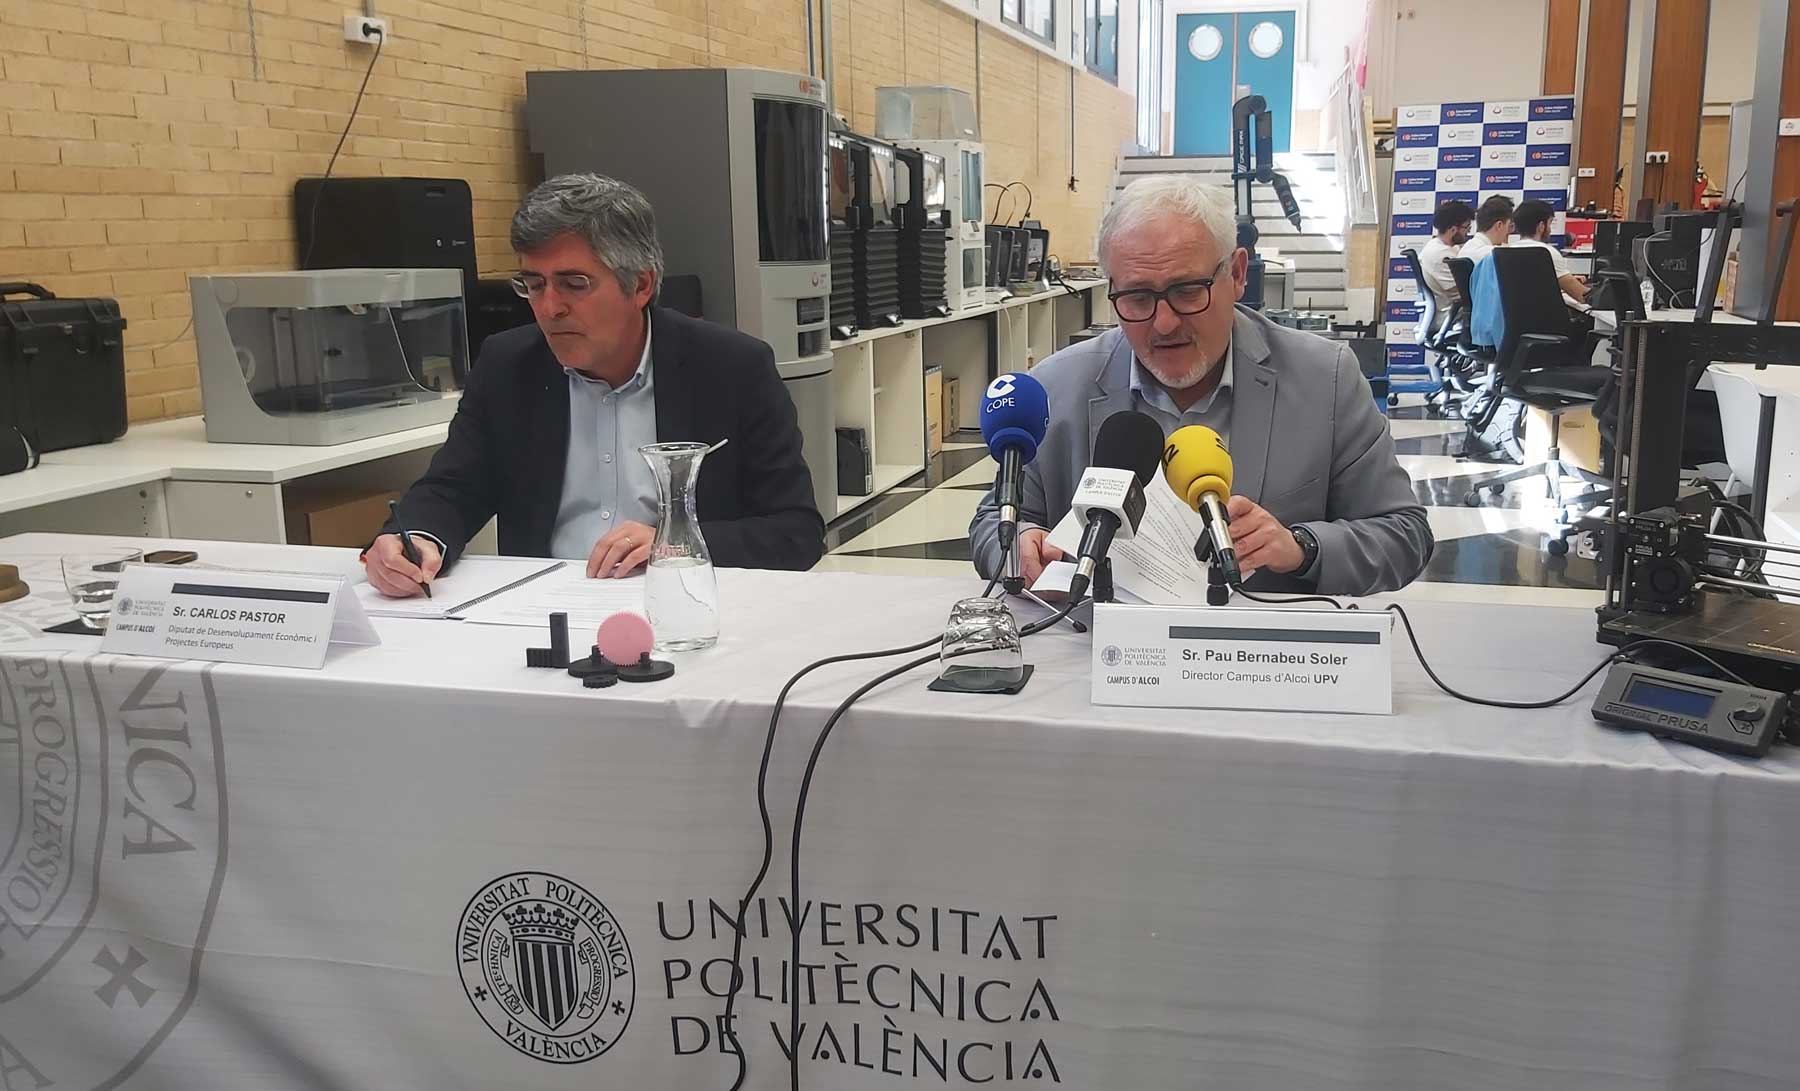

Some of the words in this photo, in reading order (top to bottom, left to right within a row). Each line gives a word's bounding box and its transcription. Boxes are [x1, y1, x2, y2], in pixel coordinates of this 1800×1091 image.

[986, 397, 1015, 413] COPE
[173, 606, 186, 617] Sr.
[190, 607, 237, 621] CARLOS
[239, 610, 286, 624] PASTOR
[116, 623, 133, 631] CAMPUS
[168, 624, 195, 635] Diputat
[196, 626, 206, 635] de
[207, 627, 274, 640] Desenvolupament
[275, 632, 312, 643] Econòmic
[312, 632, 318, 643] i
[165, 637, 199, 648] Projectes
[199, 639, 234, 650] Europeus
[1182, 648, 1201, 661] Sr.
[1205, 649, 1232, 662] Pau
[1237, 651, 1305, 664] Bernabeu
[1309, 653, 1348, 666] Soler
[1106, 675, 1131, 685] CAMPUS
[1131, 676, 1160, 685] D'ALCOI
[1182, 670, 1224, 682] Director
[1226, 671, 1271, 684] Campus
[1274, 671, 1310, 683] d'Alcoi
[1313, 673, 1339, 685] UPV
[1604, 704, 1652, 722] ORIGINAL
[1656, 714, 1709, 734] PRUSA
[7, 656, 69, 914] PROGRESSIO
[545, 880, 629, 980] POLITÈCNICA
[657, 896, 1058, 961] UNIVERSITAT
[663, 951, 1060, 1022] POLITÈCNICA
[505, 1019, 607, 1059] VALÈNCIA
[671, 1014, 738, 1055] DE
[770, 1015, 1061, 1083] VALÈNCIA
